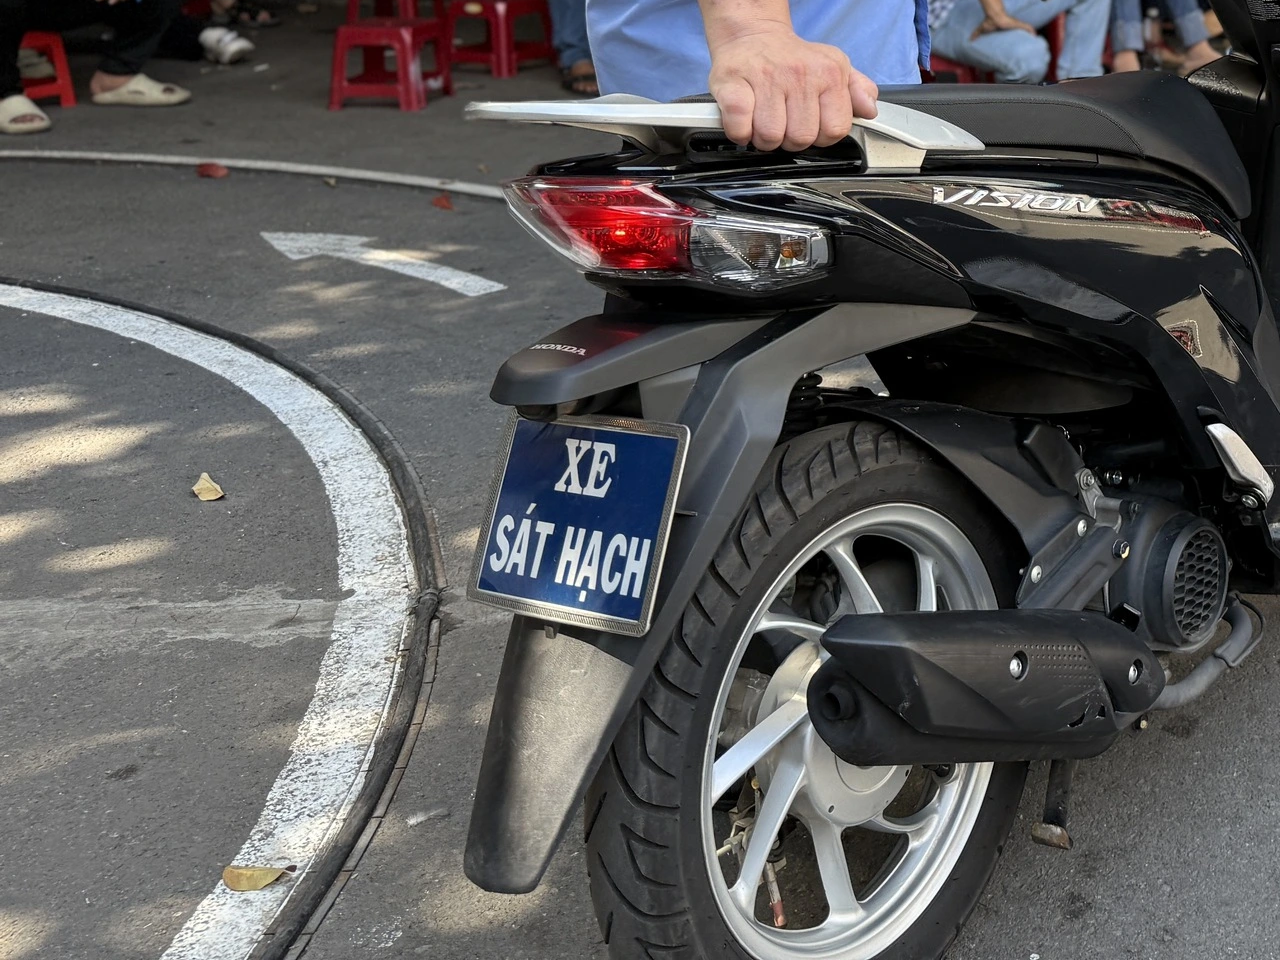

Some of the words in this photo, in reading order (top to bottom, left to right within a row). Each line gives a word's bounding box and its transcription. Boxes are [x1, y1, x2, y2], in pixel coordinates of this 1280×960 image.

[931, 186, 1101, 214] VISION
[529, 343, 588, 356] HONDA
[553, 437, 617, 499] XE
[489, 502, 556, 580] SÁT
[554, 525, 652, 603] HẠCH
